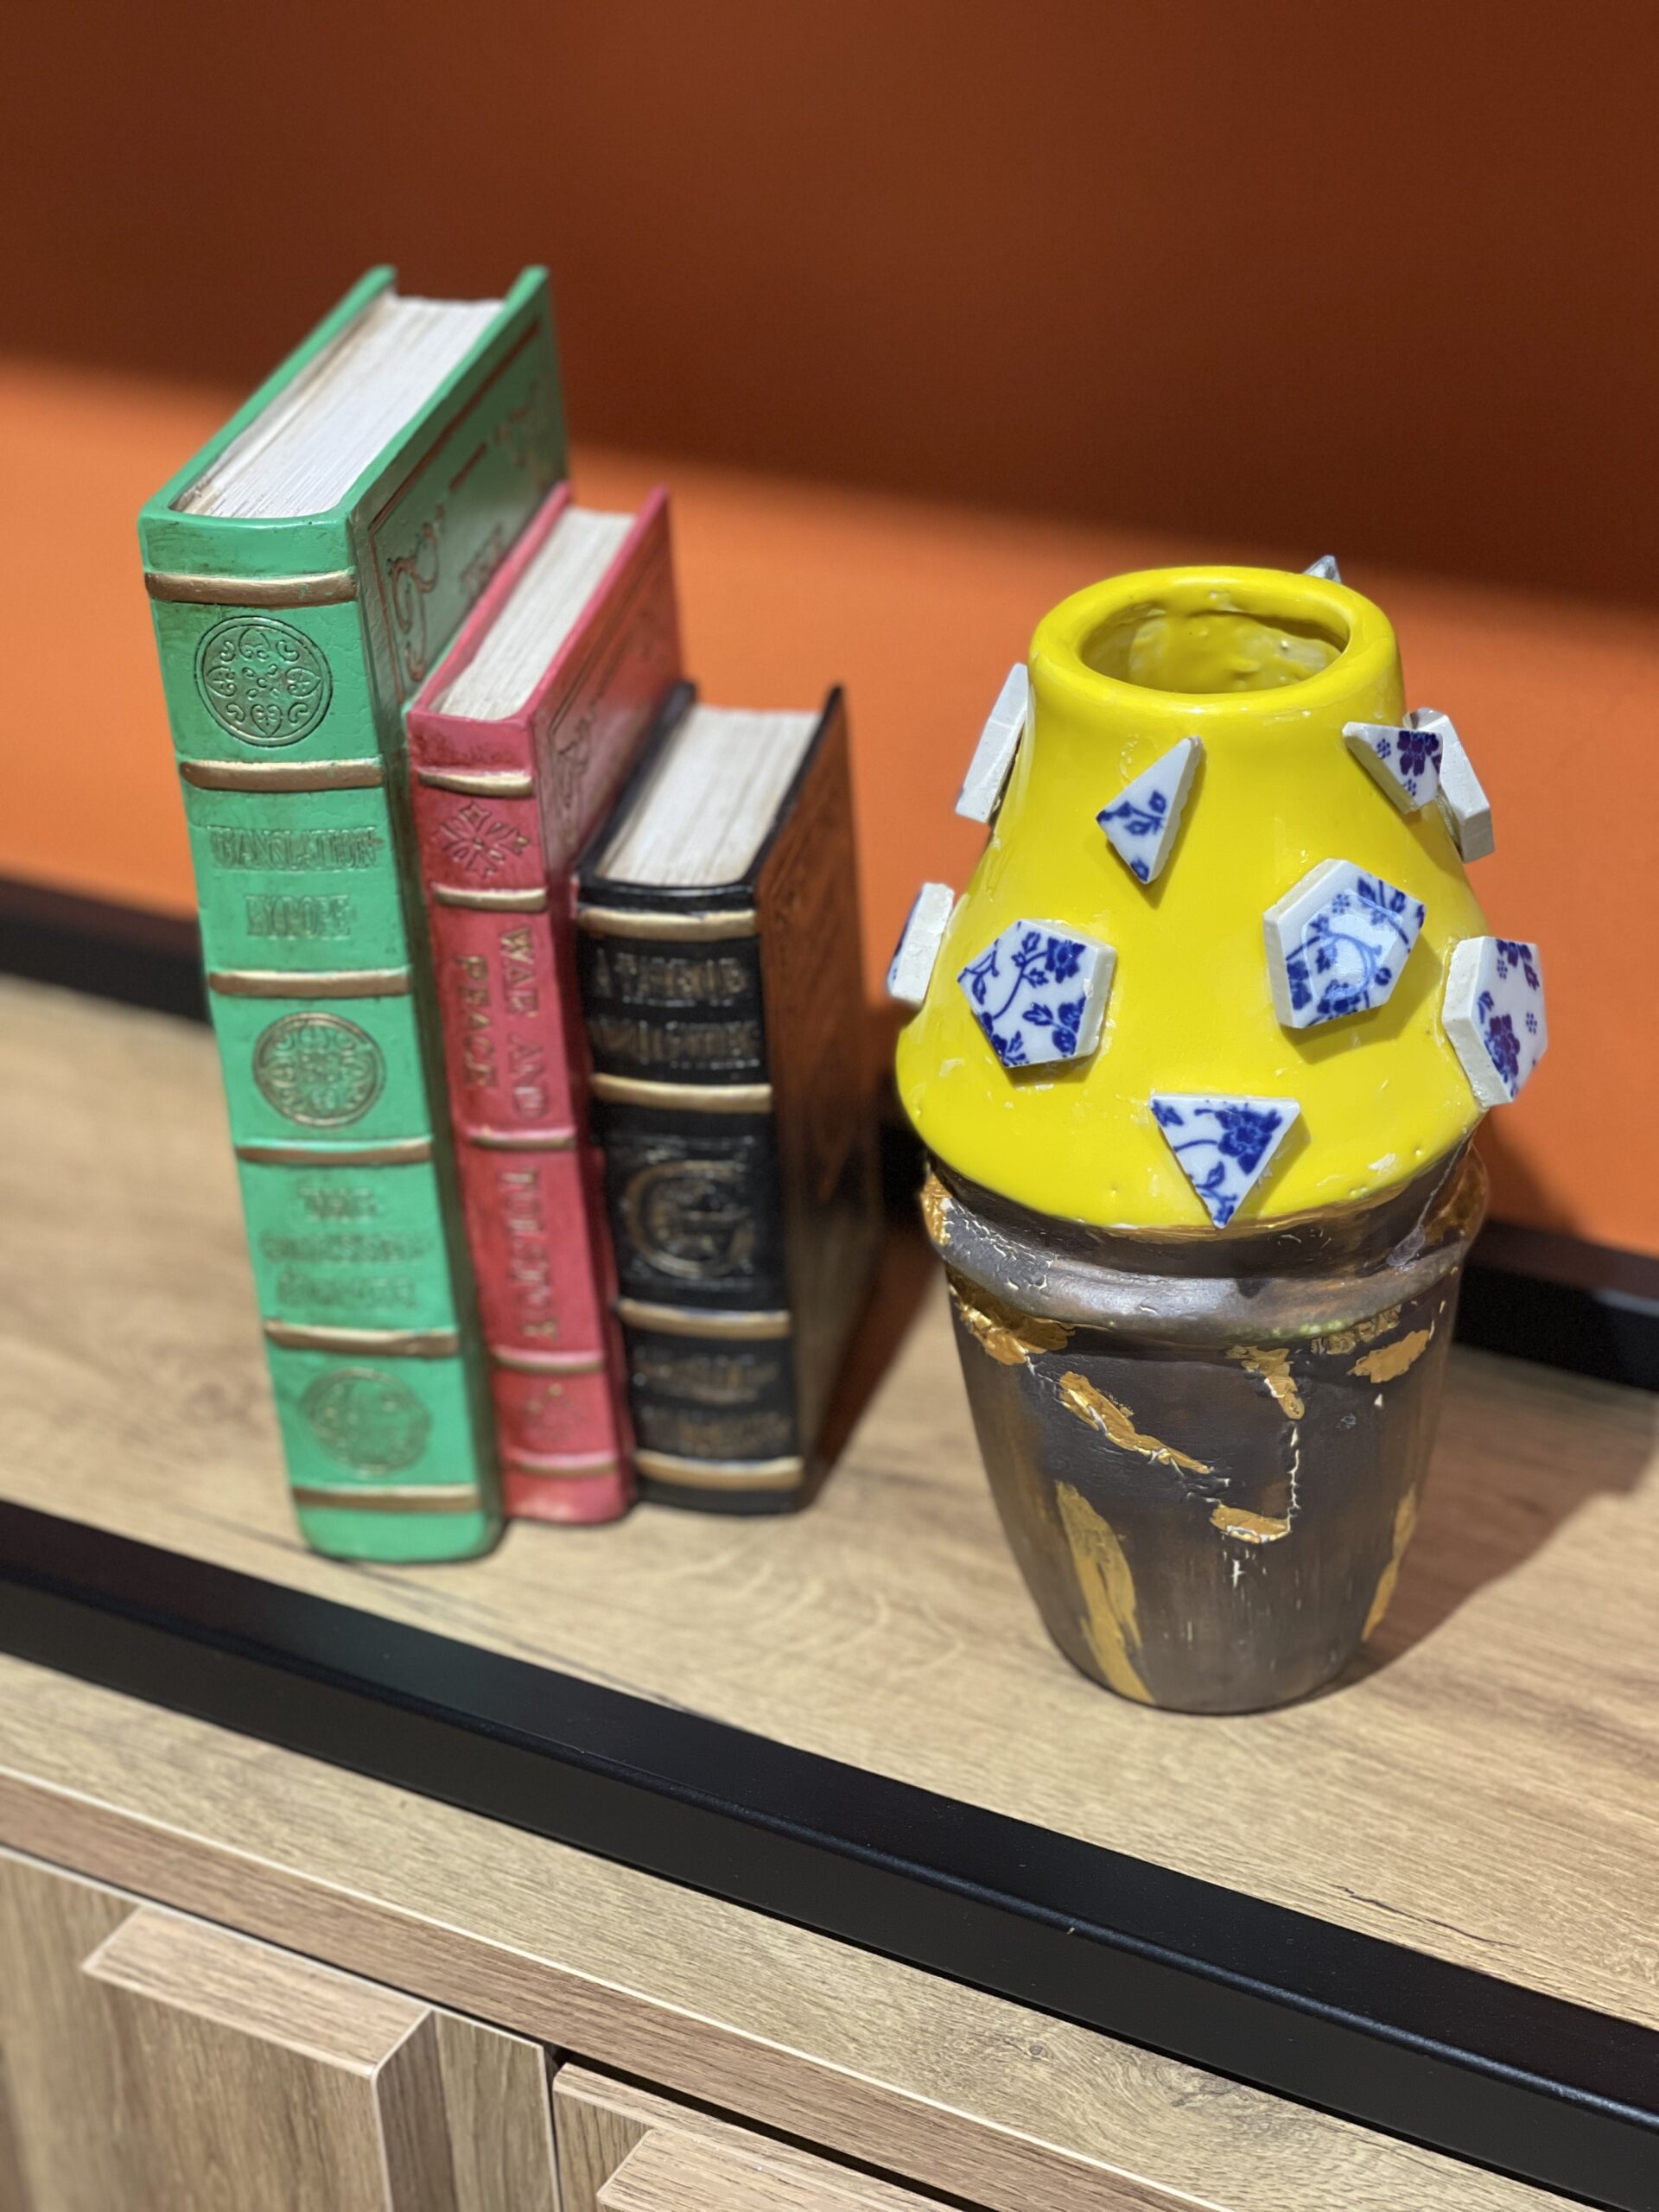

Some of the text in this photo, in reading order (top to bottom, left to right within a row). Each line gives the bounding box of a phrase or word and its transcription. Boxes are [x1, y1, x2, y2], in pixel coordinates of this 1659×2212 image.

[454, 954, 499, 1088] PEACE
[499, 925, 549, 1118] WAR AND
